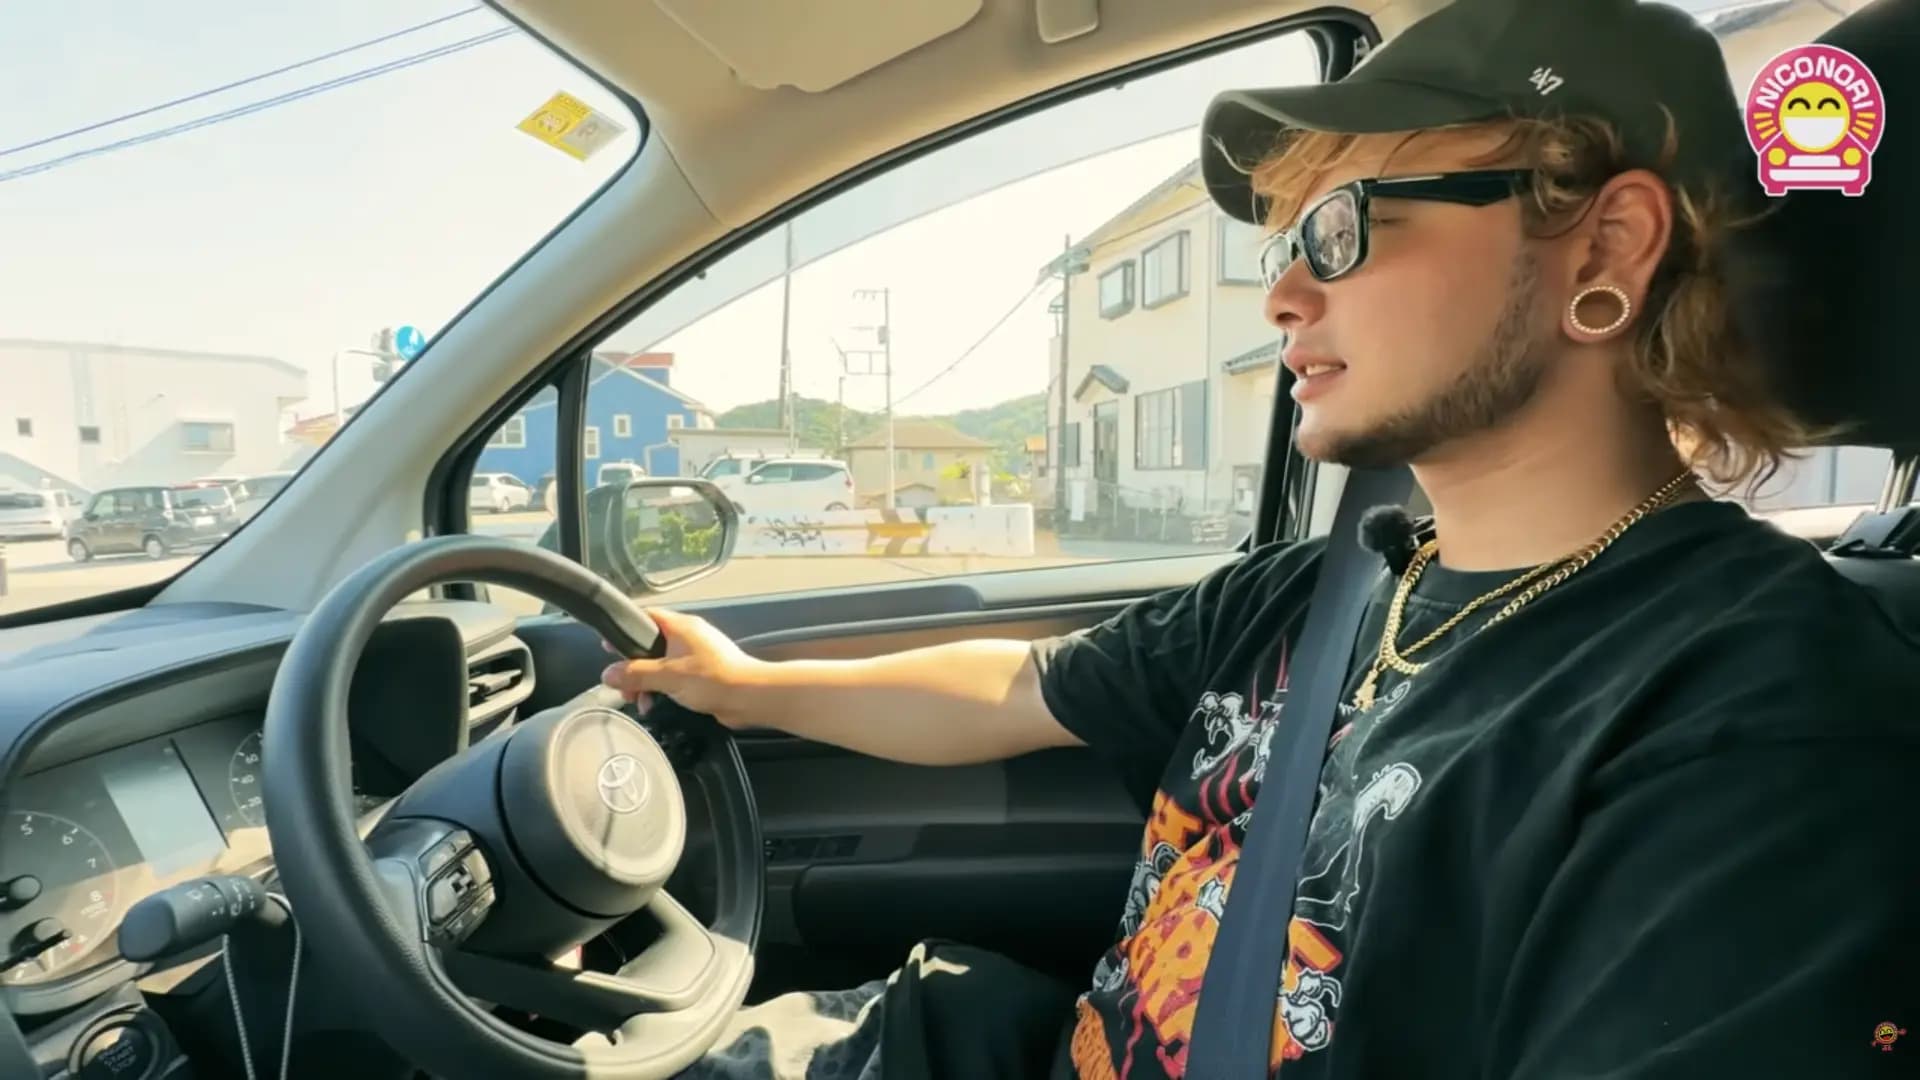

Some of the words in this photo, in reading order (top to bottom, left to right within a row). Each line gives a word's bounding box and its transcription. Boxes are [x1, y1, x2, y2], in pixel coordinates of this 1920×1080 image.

[20, 823, 33, 836] 5
[61, 834, 74, 846] 6
[87, 857, 97, 869] 7
